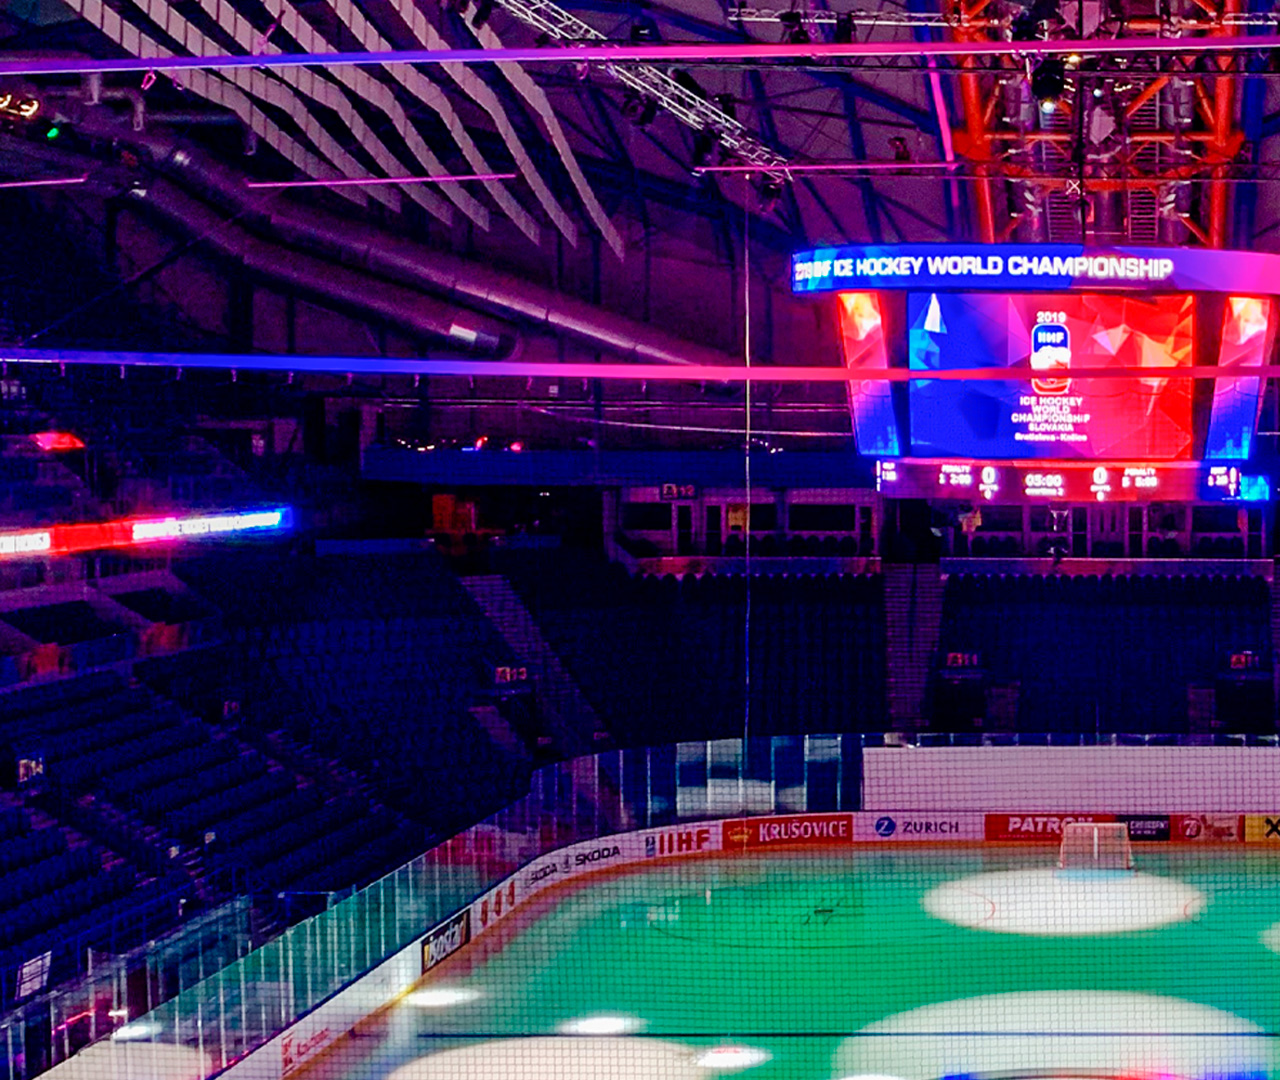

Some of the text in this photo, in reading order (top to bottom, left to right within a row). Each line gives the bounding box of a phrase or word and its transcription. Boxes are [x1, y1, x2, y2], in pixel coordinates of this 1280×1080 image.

[833, 259, 853, 276] ICE
[856, 256, 923, 276] HOCKEY
[927, 256, 1003, 275] WORLD
[1008, 256, 1174, 279] CHAMPIONSHIP
[1036, 311, 1066, 323] 2019
[1020, 397, 1083, 406] ICE HOCKEY
[1031, 405, 1071, 414] WORLD
[1011, 413, 1090, 423] CHAMPIONSHIP
[1028, 422, 1074, 432] SLOVAKIA
[981, 466, 996, 485] 0
[1092, 466, 1108, 485] 0
[759, 819, 848, 842] KRUŠOVICE
[903, 820, 959, 835] ZURICH
[659, 828, 710, 855] IIHF
[428, 919, 465, 967] isostar
